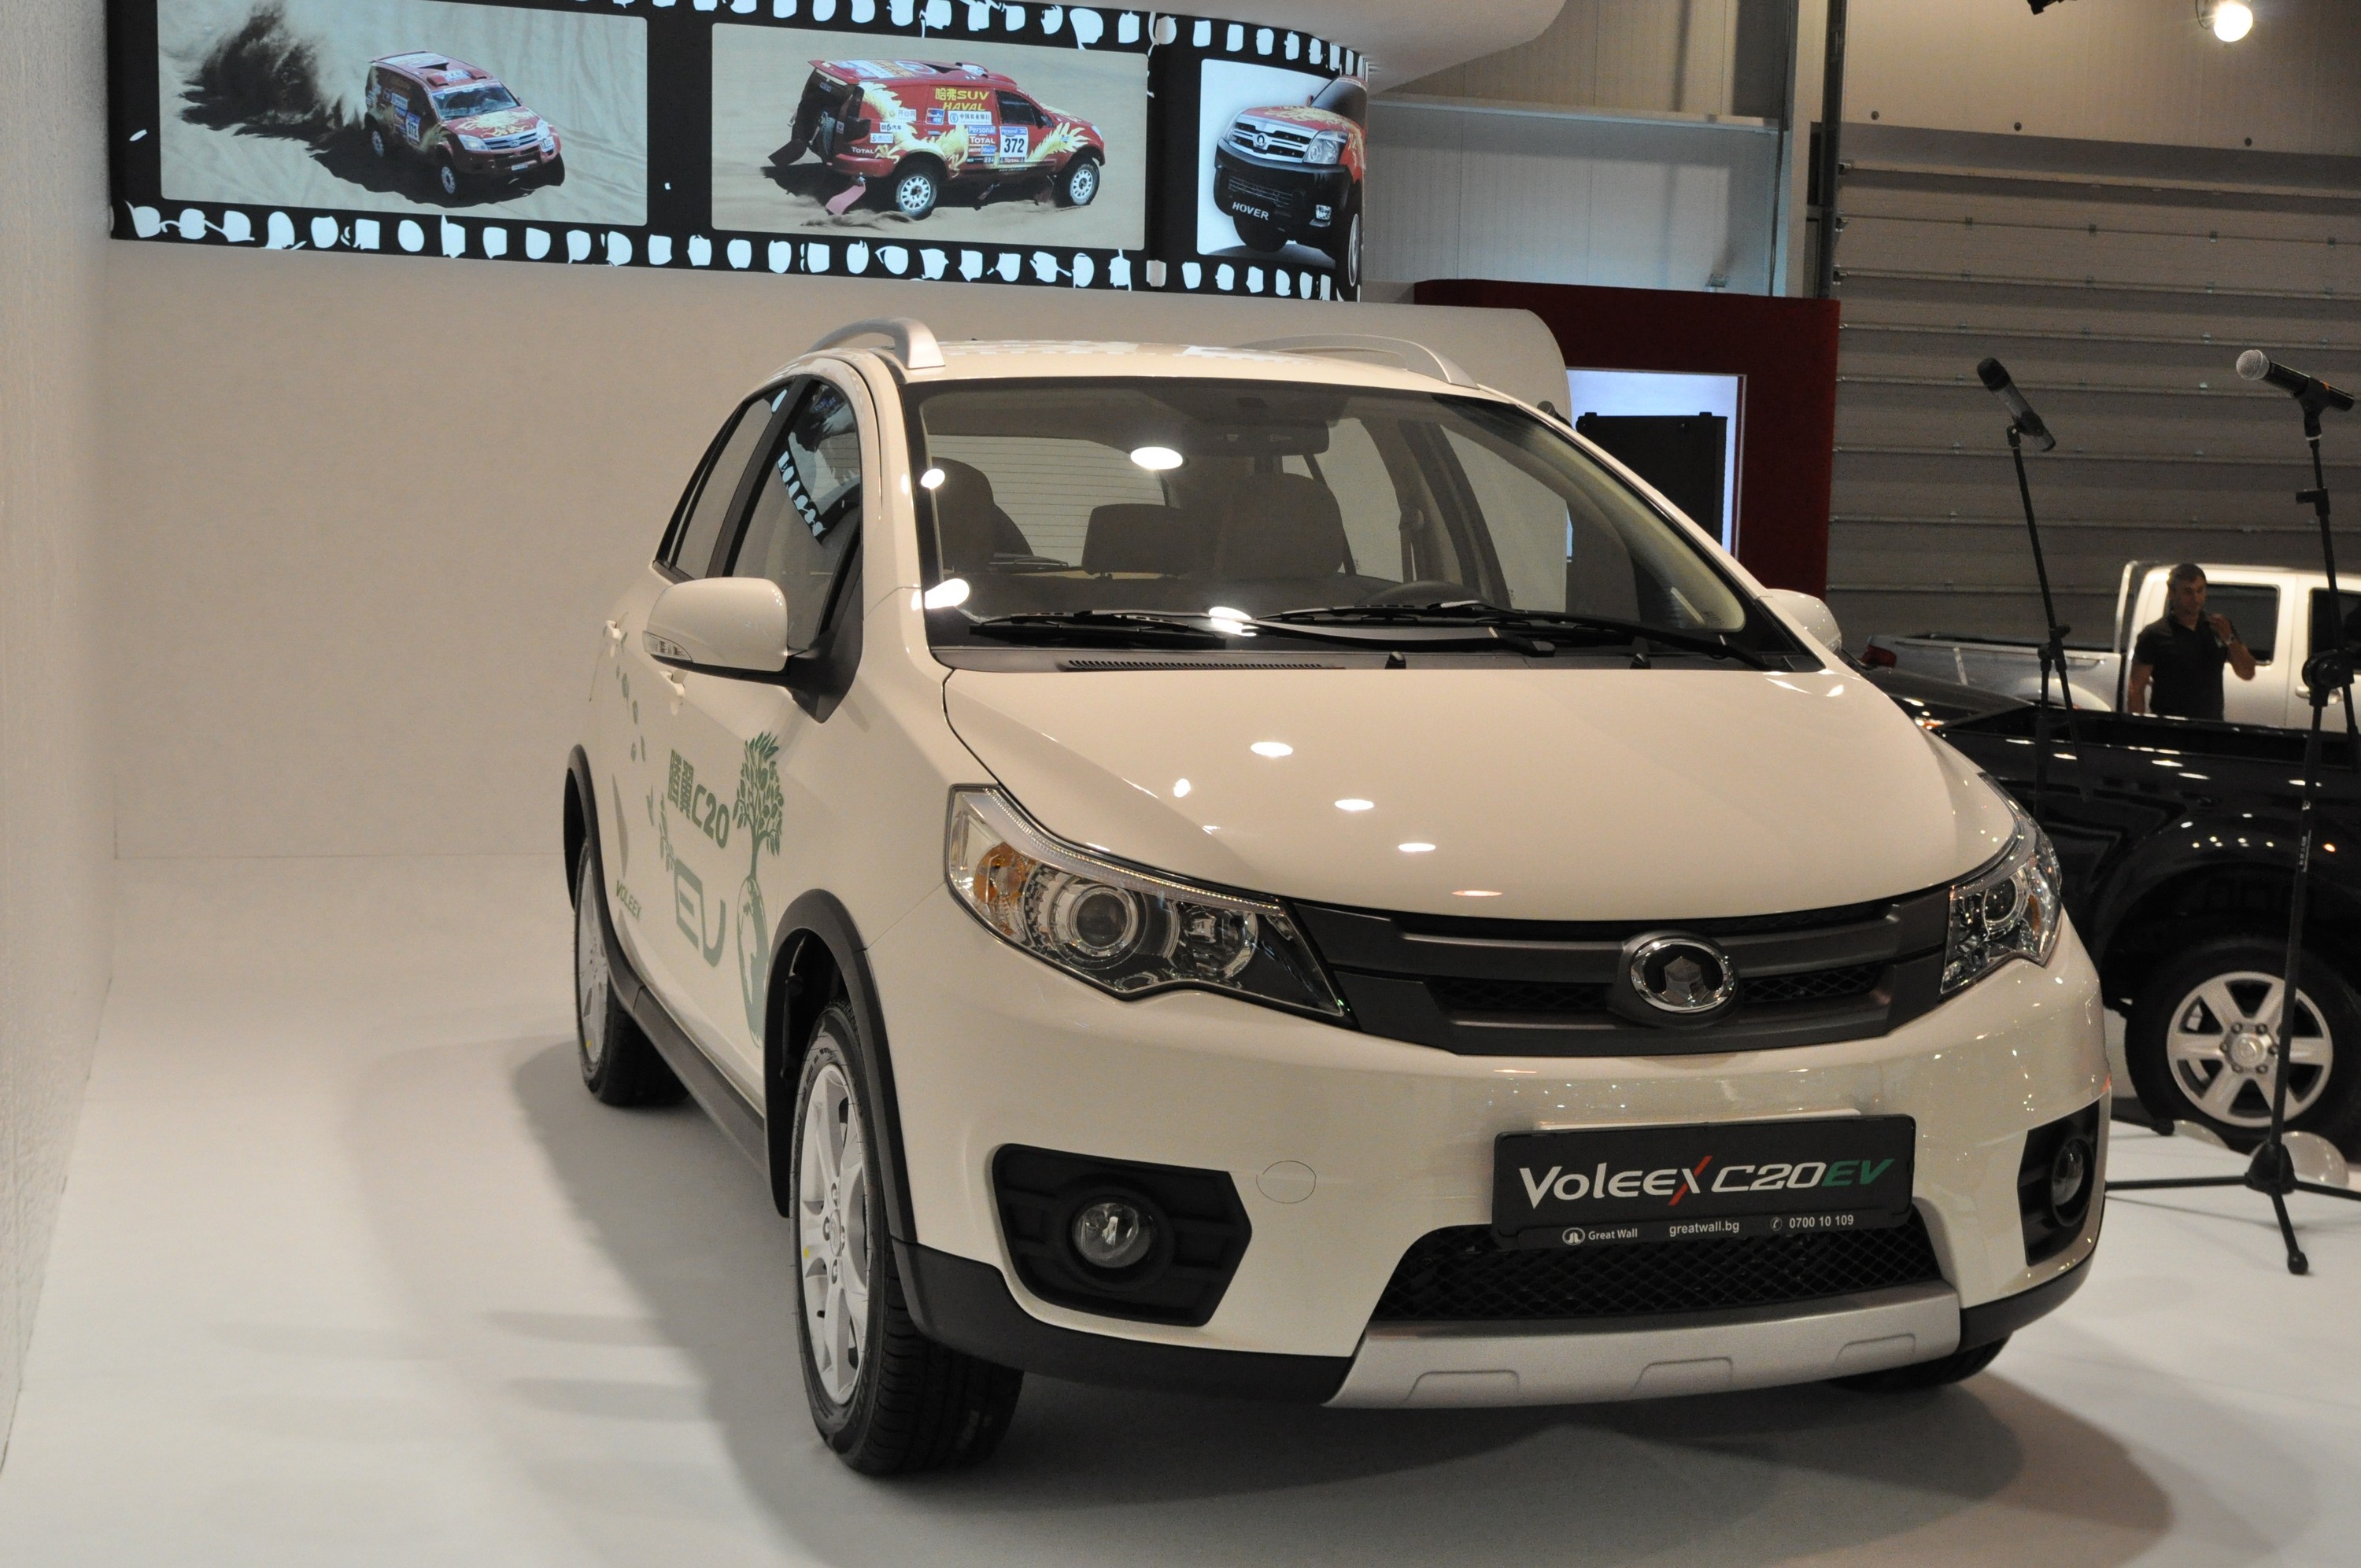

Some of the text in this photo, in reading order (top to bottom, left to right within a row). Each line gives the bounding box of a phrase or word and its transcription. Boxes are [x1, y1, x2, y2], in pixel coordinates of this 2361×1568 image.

[935, 88, 989, 101] 哈弗SUV
[944, 101, 985, 111] HAVAL
[969, 125, 996, 134] Personal
[1003, 138, 1025, 153] 372
[1232, 201, 1269, 220] HOVER
[1789, 1214, 1854, 1228] 0700 10 109
[1588, 1228, 1638, 1241] Great Wall
[1669, 1220, 1740, 1237] greatwall.bg
